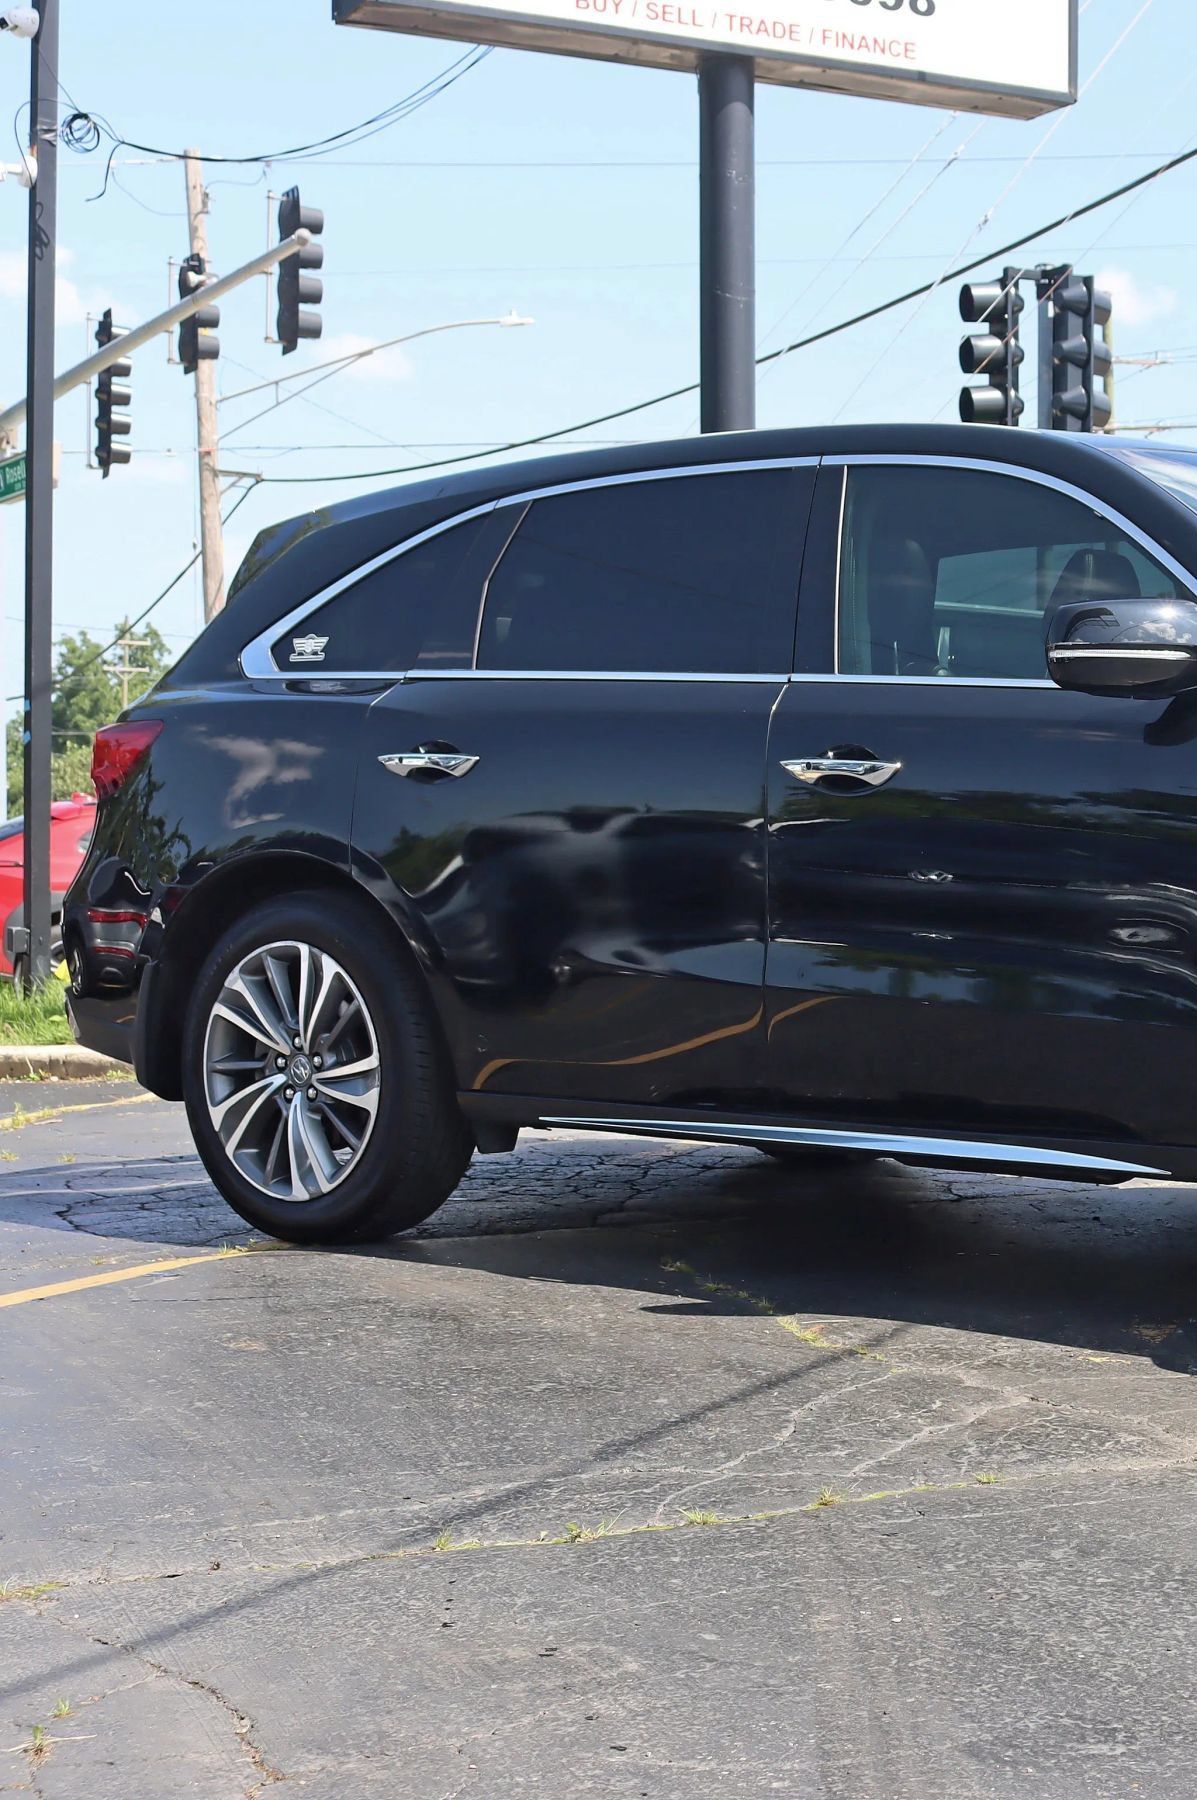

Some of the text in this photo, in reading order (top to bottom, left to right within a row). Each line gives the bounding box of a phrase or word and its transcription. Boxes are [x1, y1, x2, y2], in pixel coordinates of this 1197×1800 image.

[576, 0, 623, 14] BUY
[646, 2, 704, 27] SELL
[725, 13, 801, 41] TRADE
[822, 28, 917, 60] FINANCE
